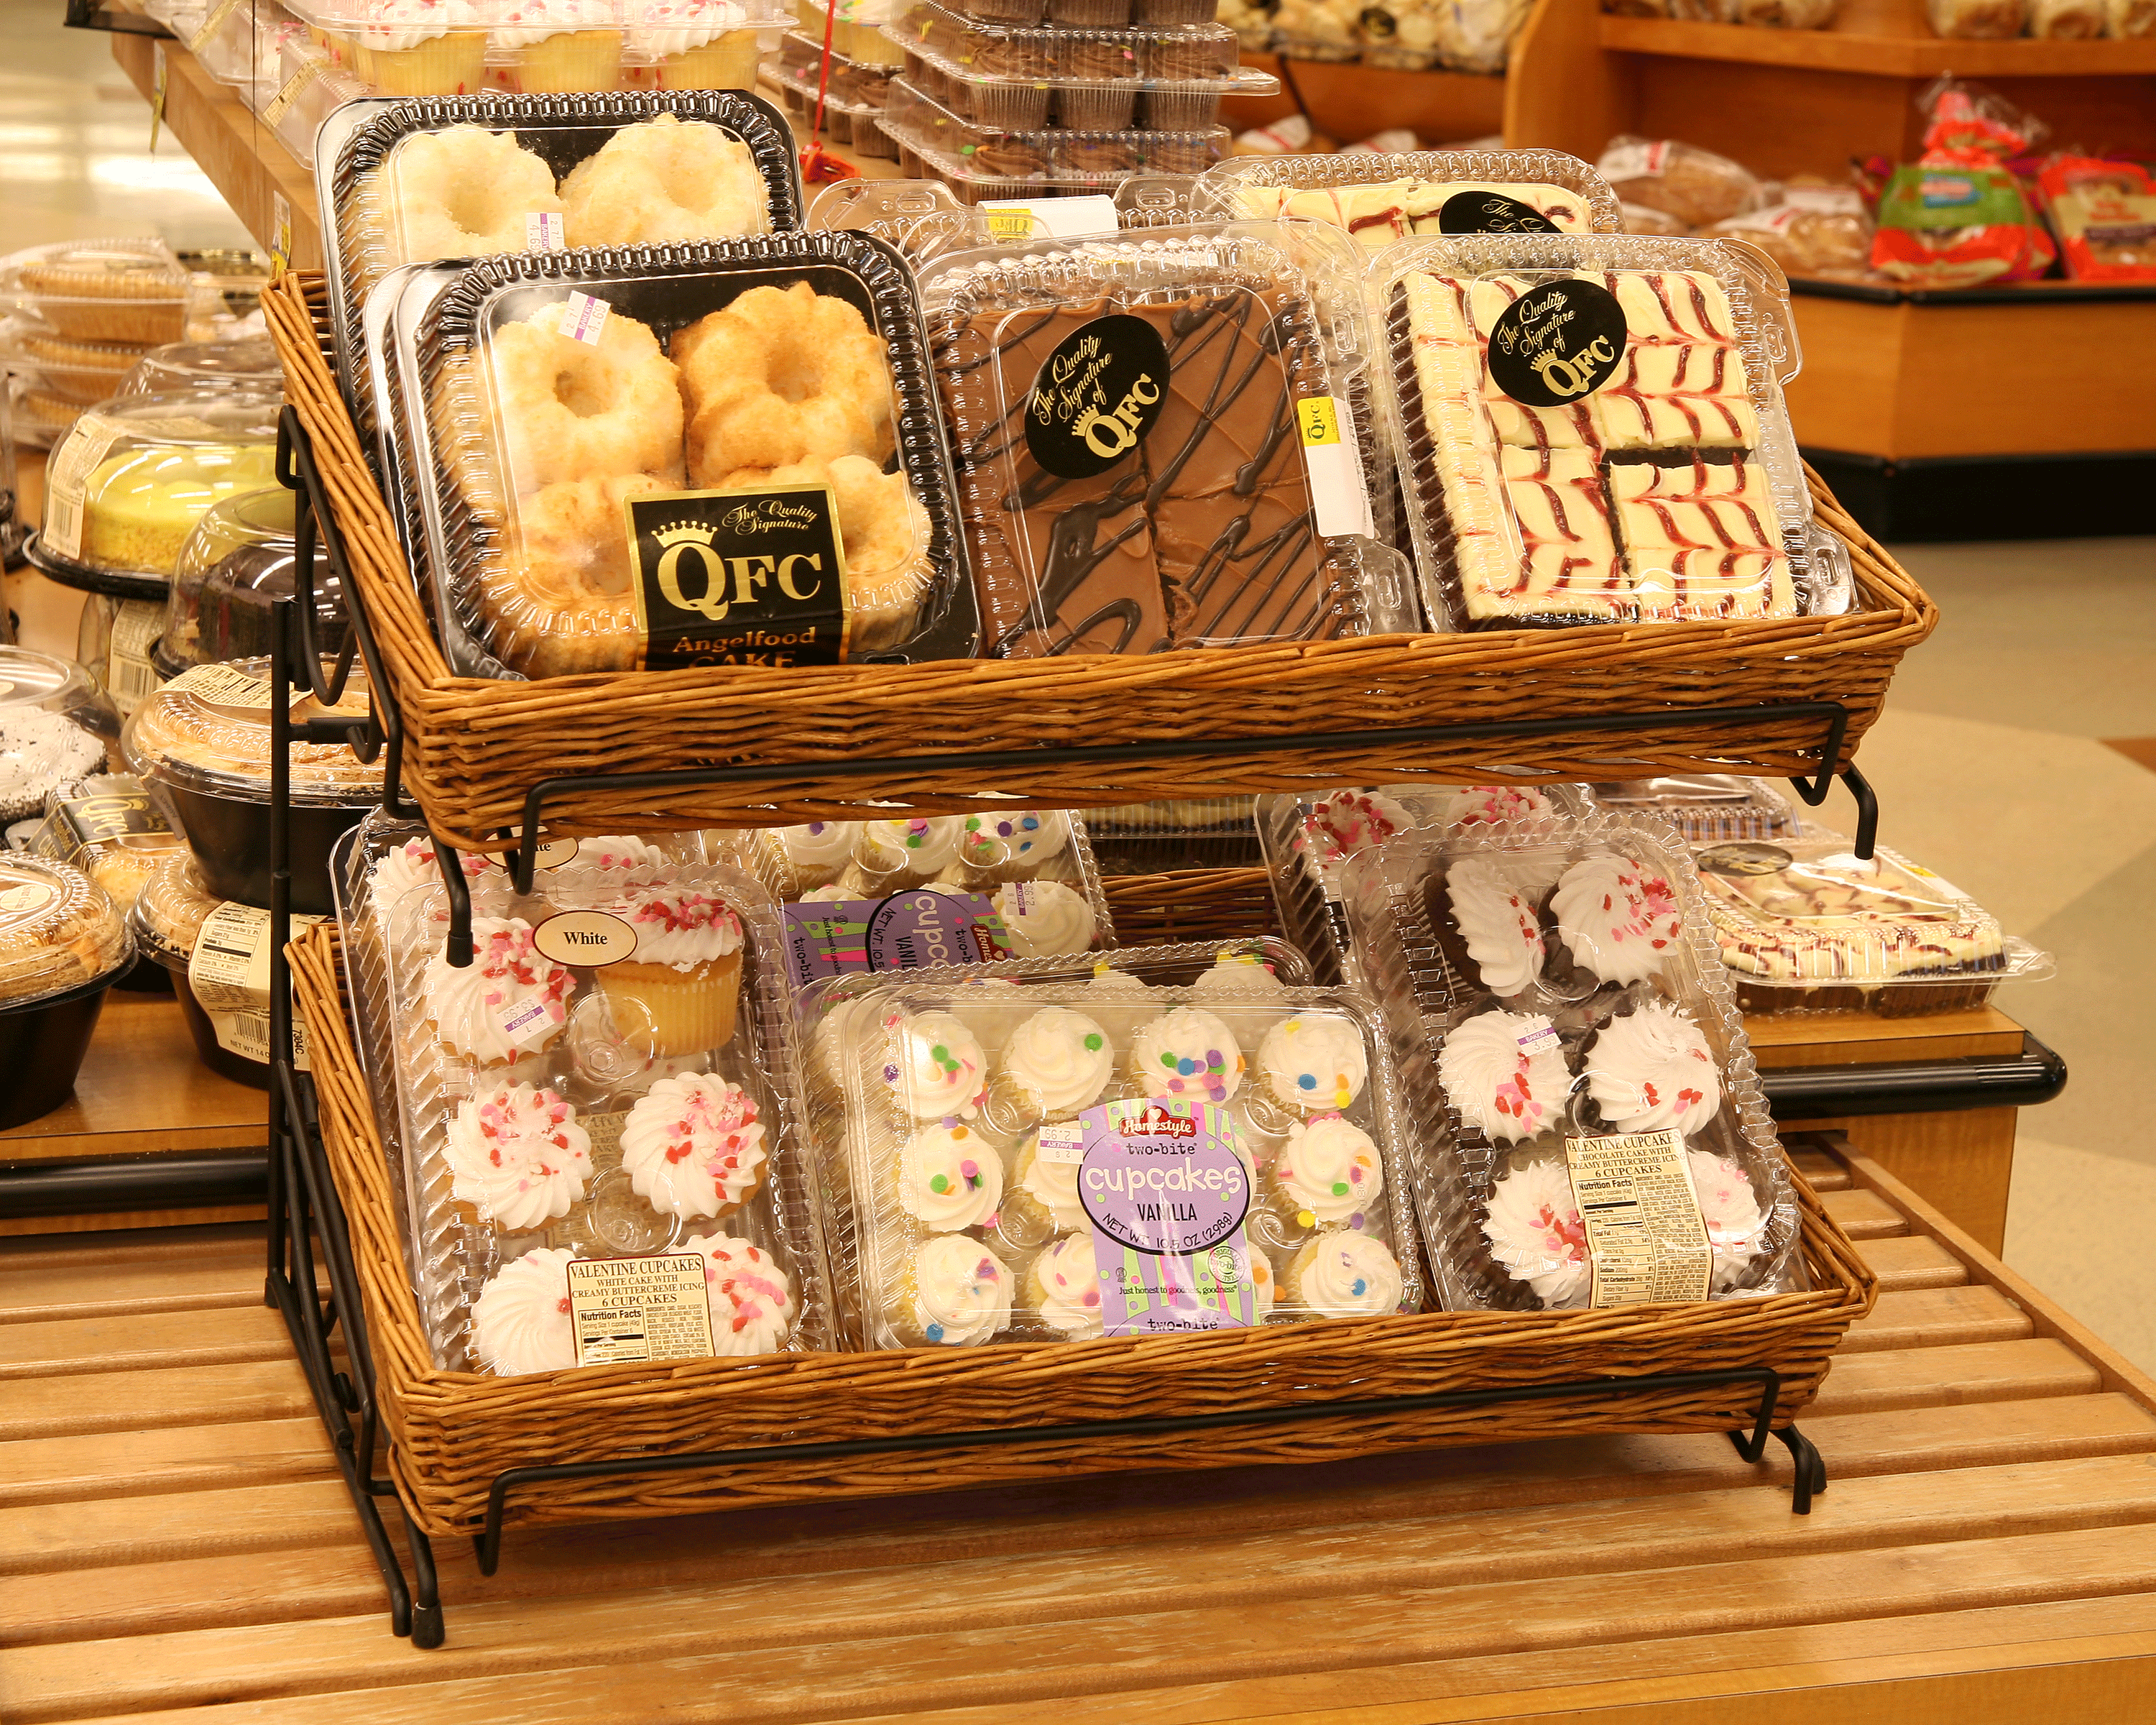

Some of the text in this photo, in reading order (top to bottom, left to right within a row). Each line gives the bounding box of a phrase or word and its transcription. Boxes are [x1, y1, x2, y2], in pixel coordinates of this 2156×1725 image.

[1482, 199, 1514, 218] The
[541, 224, 550, 249] BAKERY
[579, 303, 592, 329] BAKERY
[588, 305, 606, 332] 4.69
[1498, 291, 1568, 354] The Quality
[1520, 310, 1575, 357] Signature
[1554, 328, 1566, 351] of
[1542, 335, 1615, 396] QFC
[1033, 335, 1102, 426] The Quality
[1058, 353, 1113, 423] Signature
[1093, 378, 1107, 405] of
[1085, 373, 1159, 458] QFC
[1309, 404, 1326, 439] QFC
[722, 500, 817, 527] The Quality
[735, 517, 808, 535] Signature
[658, 542, 821, 621] QFC
[673, 627, 816, 653] Angelfood
[75, 799, 132, 835] QFC
[1024, 886, 1035, 906] 2.99
[878, 908, 897, 927] NET
[563, 932, 607, 944] White
[913, 896, 951, 969] cupca
[895, 936, 918, 970] VANIL
[956, 929, 973, 963] two-b
[975, 927, 992, 962] Homes
[793, 937, 815, 985] two-bit
[872, 948, 885, 968] 10.5
[512, 1011, 536, 1029] BAKERY
[1525, 1030, 1548, 1042] BAKERY
[1532, 1036, 1557, 1050] 3.99
[1045, 1128, 1071, 1141] 2.99
[1123, 1119, 1192, 1137] Homestyle
[1567, 1131, 1680, 1152] VALENTINE CUPCAKES
[1569, 1153, 1686, 1170] CREAMY BUTTERCREME ICING
[1577, 1146, 1672, 1162] CHOCOLATE CAKE WITH
[1085, 1156, 1241, 1200] cupcakes
[1595, 1165, 1662, 1178] 6 CUPCAKES
[1579, 1182, 1611, 1190] Nutrition
[1137, 1203, 1197, 1221] VANILLA
[1103, 1213, 1128, 1234] NET
[1183, 1233, 1201, 1247] OZ
[571, 1258, 701, 1279] VALENTINE CUPCAKES
[572, 1282, 704, 1298] CREAMY BUTTERCREME ICING
[596, 1274, 678, 1287] WHITE CAKE WITH
[602, 1294, 677, 1307] 6 CUPCAKES
[581, 1310, 641, 1321] Nutrition Facts
